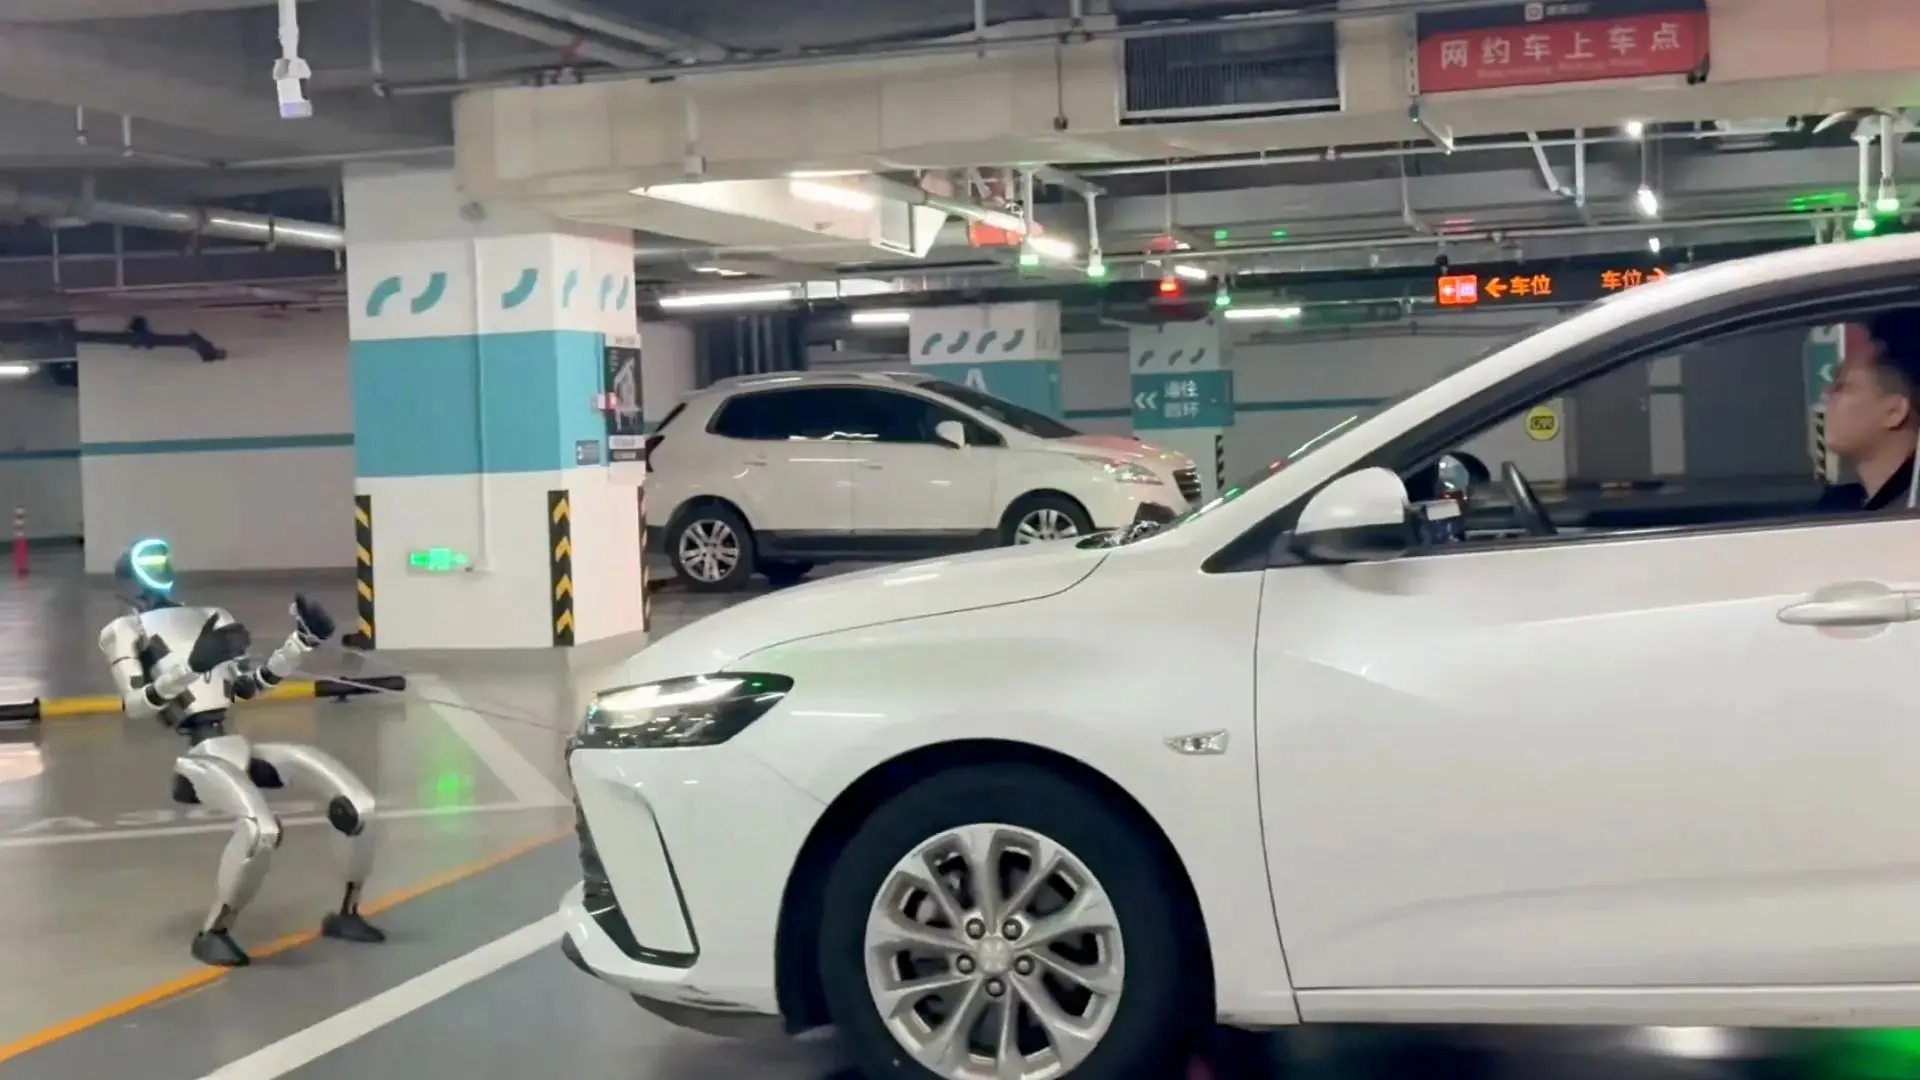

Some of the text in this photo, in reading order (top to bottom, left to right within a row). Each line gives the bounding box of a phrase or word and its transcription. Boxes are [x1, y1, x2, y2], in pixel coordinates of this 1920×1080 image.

[1440, 22, 1681, 70] 网约车上车点
[1510, 274, 1552, 296] 车位
[1601, 268, 1641, 290] 车位
